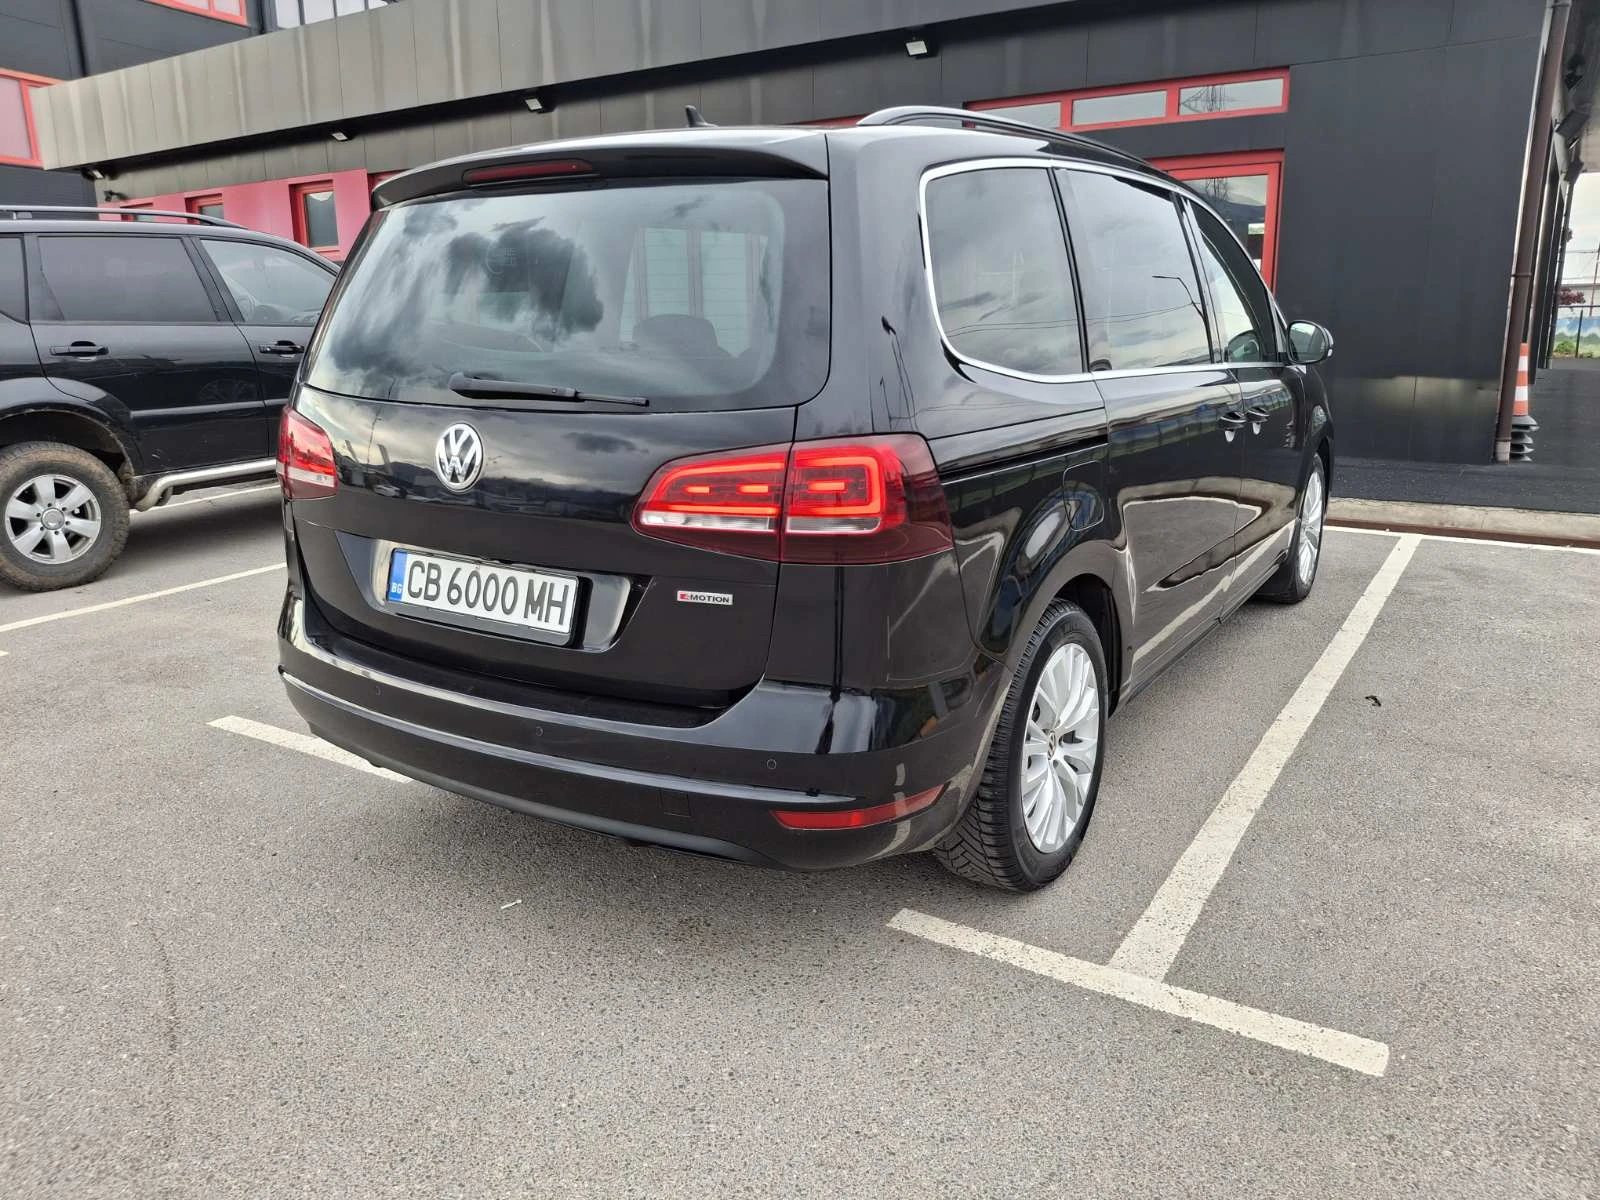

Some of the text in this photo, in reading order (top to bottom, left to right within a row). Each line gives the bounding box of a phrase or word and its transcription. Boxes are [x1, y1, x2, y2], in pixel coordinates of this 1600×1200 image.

[436, 424, 483, 490] VW
[391, 582, 403, 594] BG
[407, 560, 570, 625] CB 6000 MH
